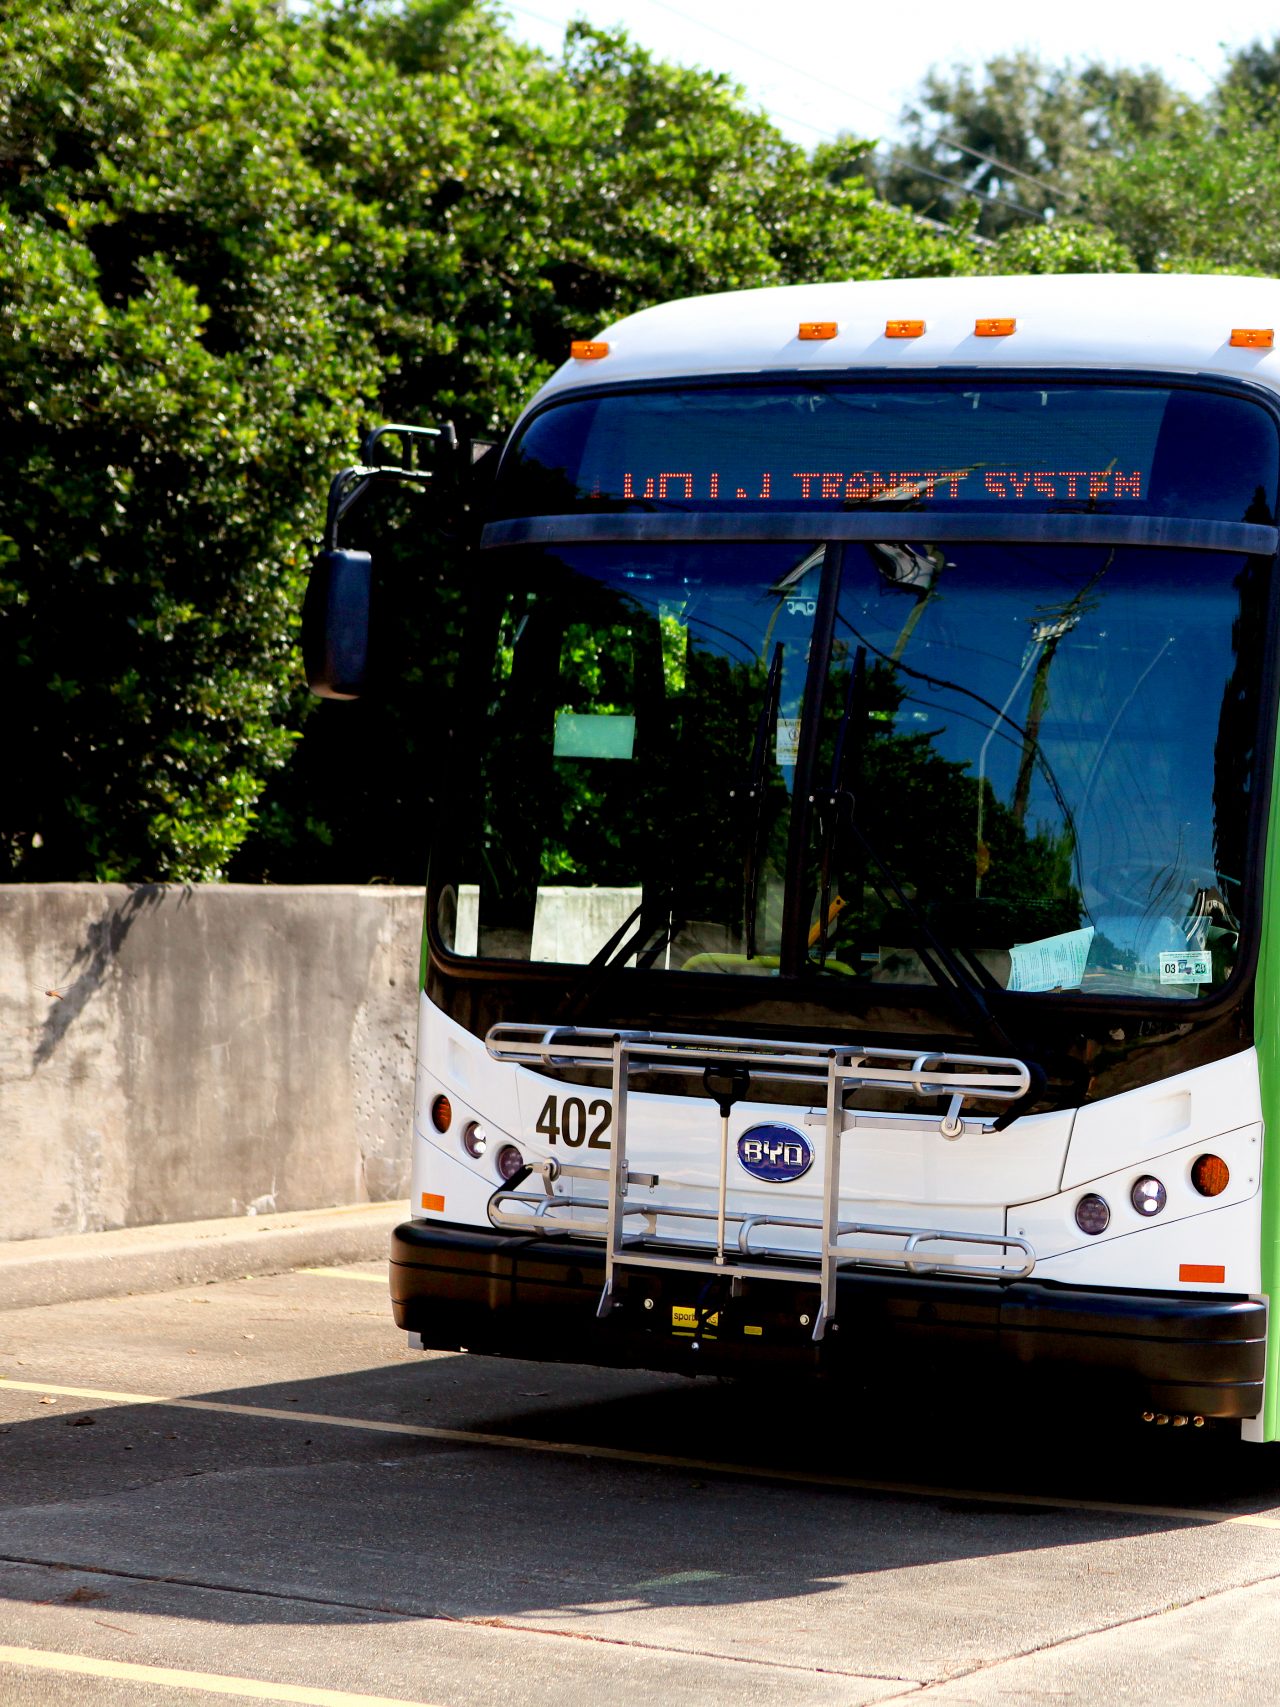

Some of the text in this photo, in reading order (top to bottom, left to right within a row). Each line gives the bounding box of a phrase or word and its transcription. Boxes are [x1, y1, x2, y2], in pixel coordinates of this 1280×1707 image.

[984, 471, 1142, 498] SYSTEM
[1164, 963, 1176, 974] 03
[535, 1094, 612, 1150] 402
[743, 1138, 804, 1166] BYD
